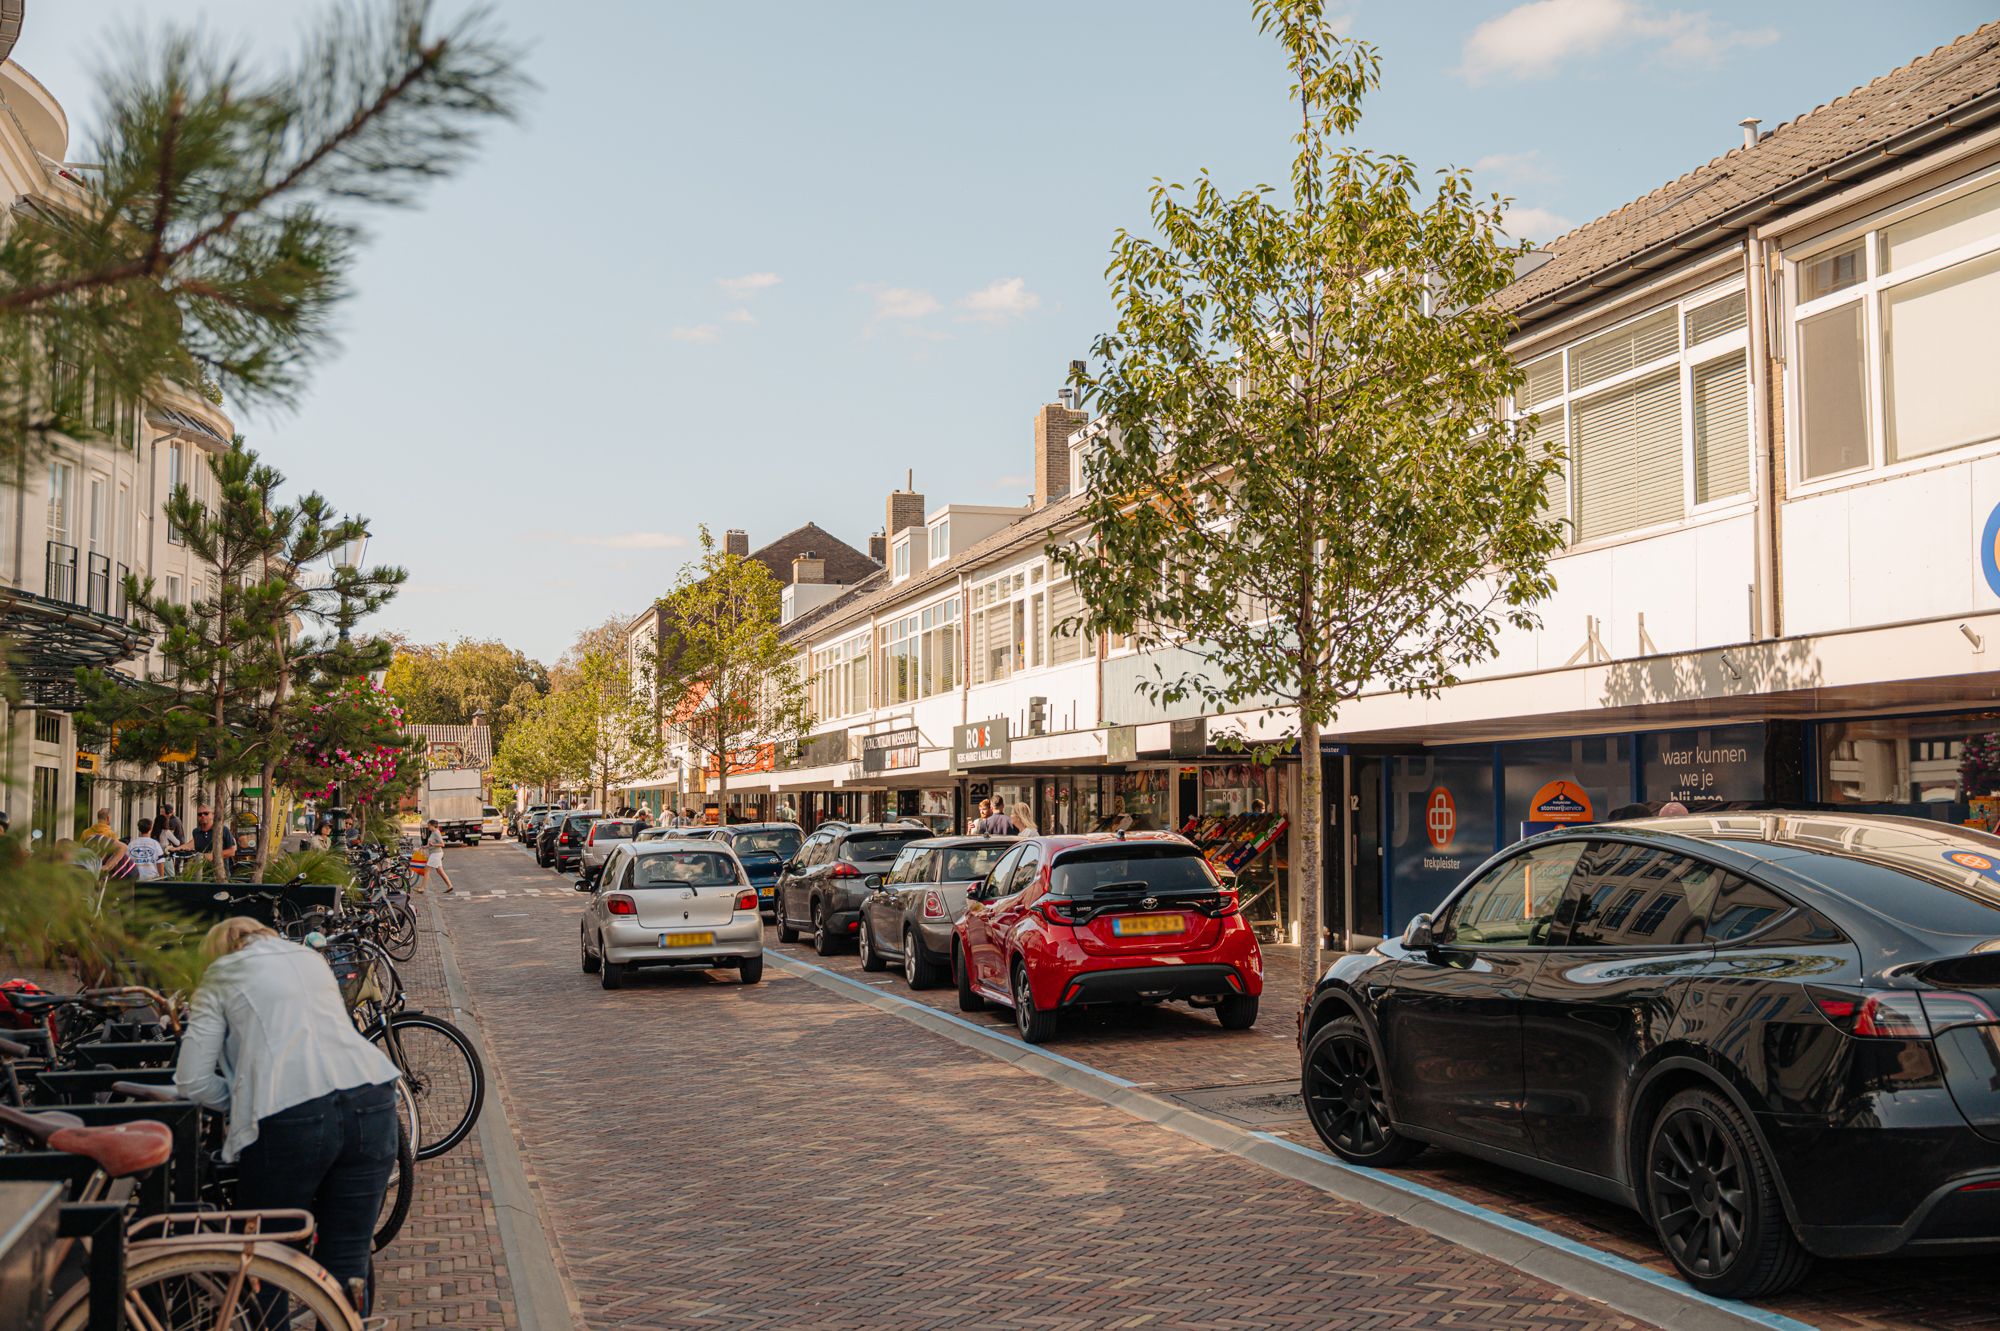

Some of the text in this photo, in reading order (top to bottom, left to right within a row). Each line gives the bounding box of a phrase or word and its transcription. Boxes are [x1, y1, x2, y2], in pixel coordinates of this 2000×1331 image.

[1662, 746, 1746, 766] waar kunnen
[1680, 768, 1714, 791] we je
[970, 783, 989, 795] 20
[1424, 856, 1460, 871] trekpleister
